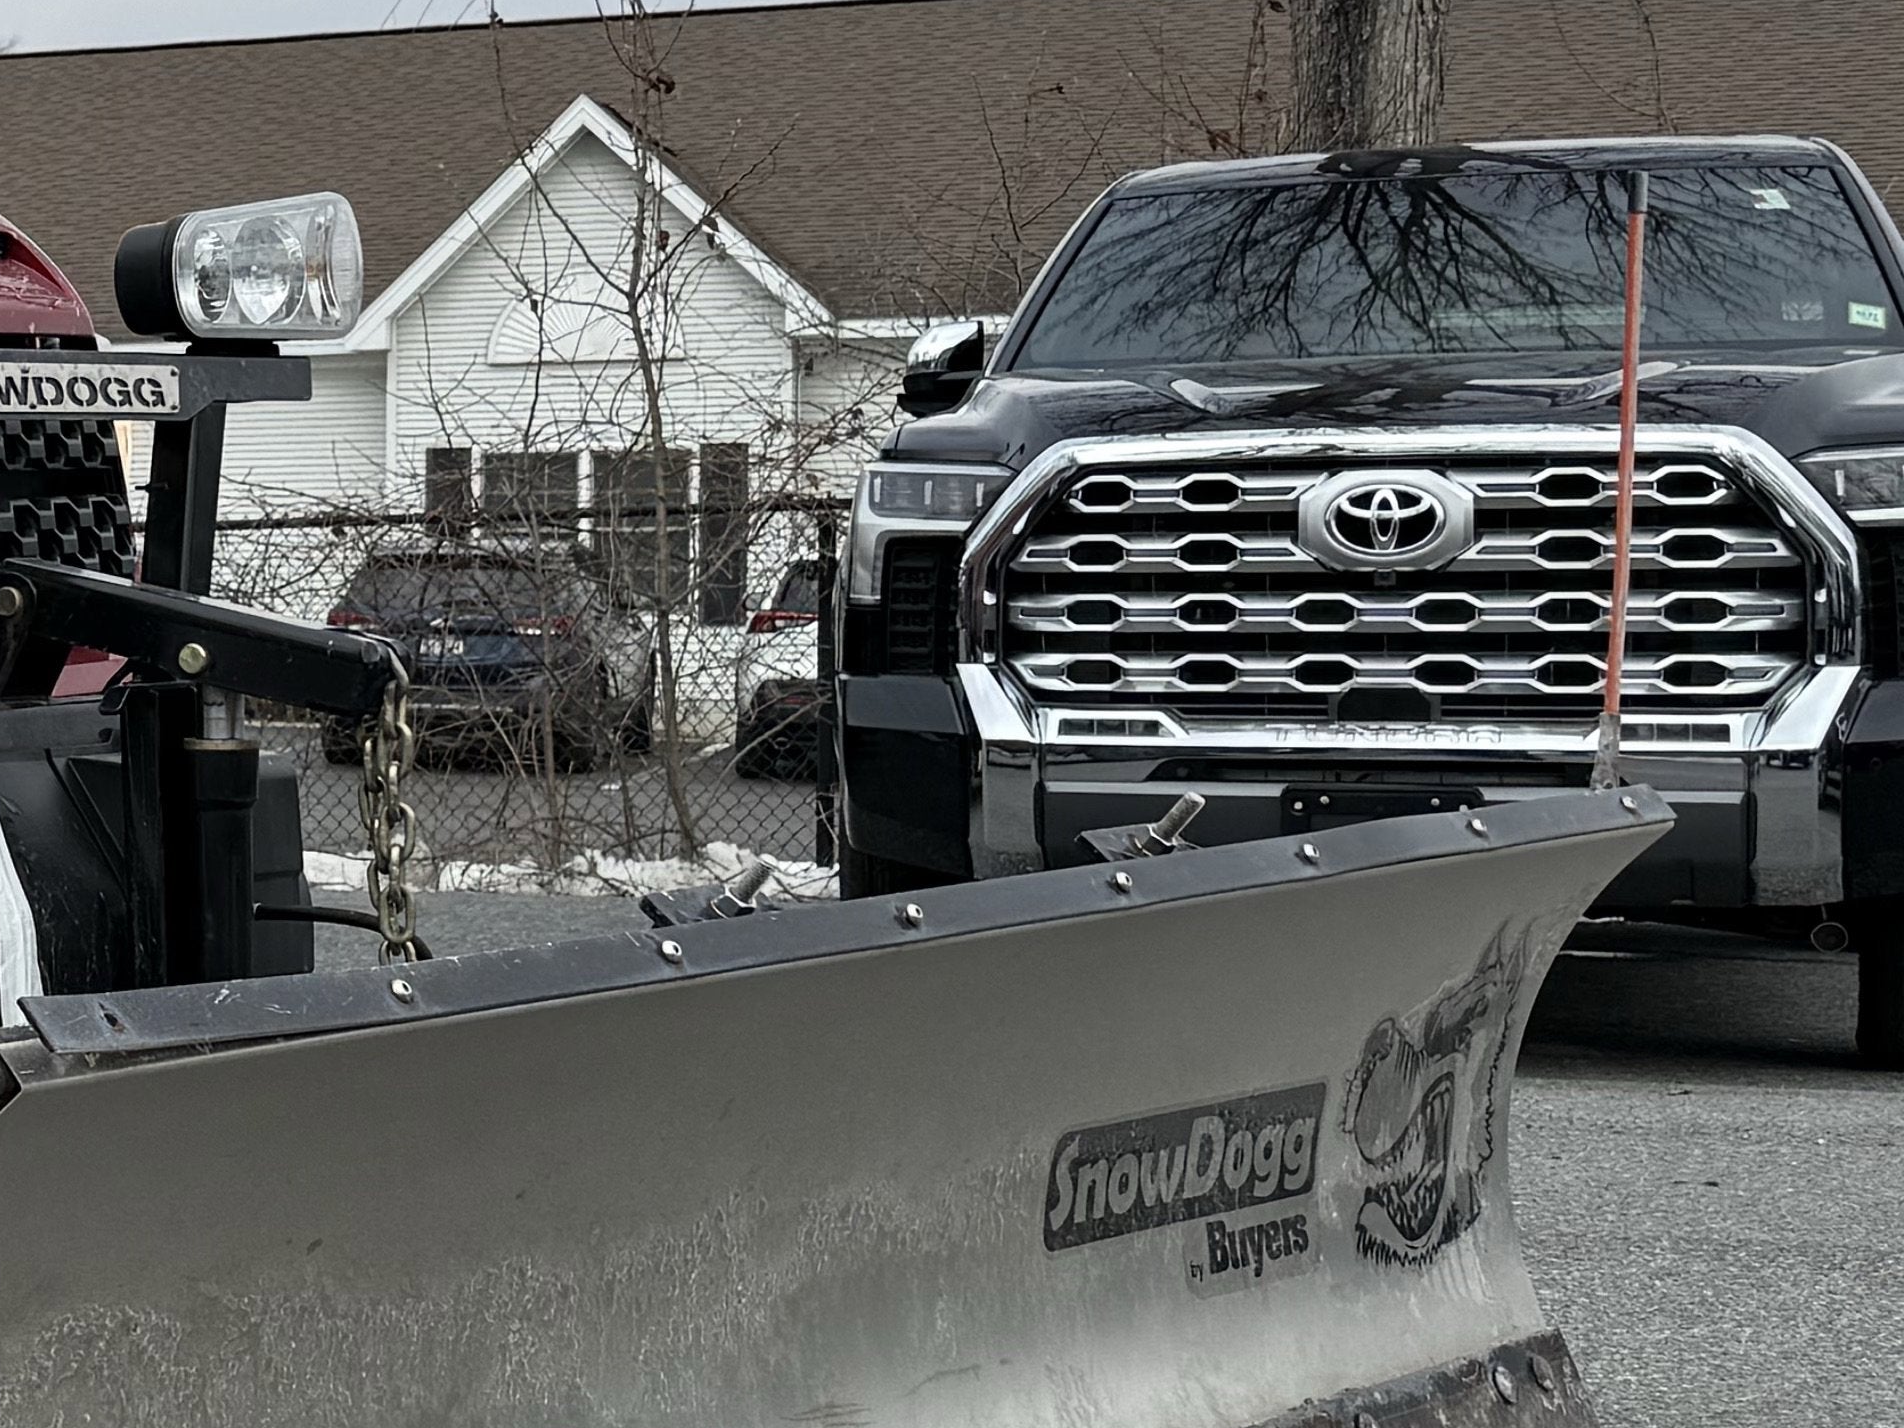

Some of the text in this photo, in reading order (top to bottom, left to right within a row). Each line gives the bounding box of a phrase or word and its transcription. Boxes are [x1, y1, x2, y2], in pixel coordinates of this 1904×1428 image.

[1048, 1115, 1317, 1232] SnowDogg
[1190, 1213, 1310, 1283] by Buyers
